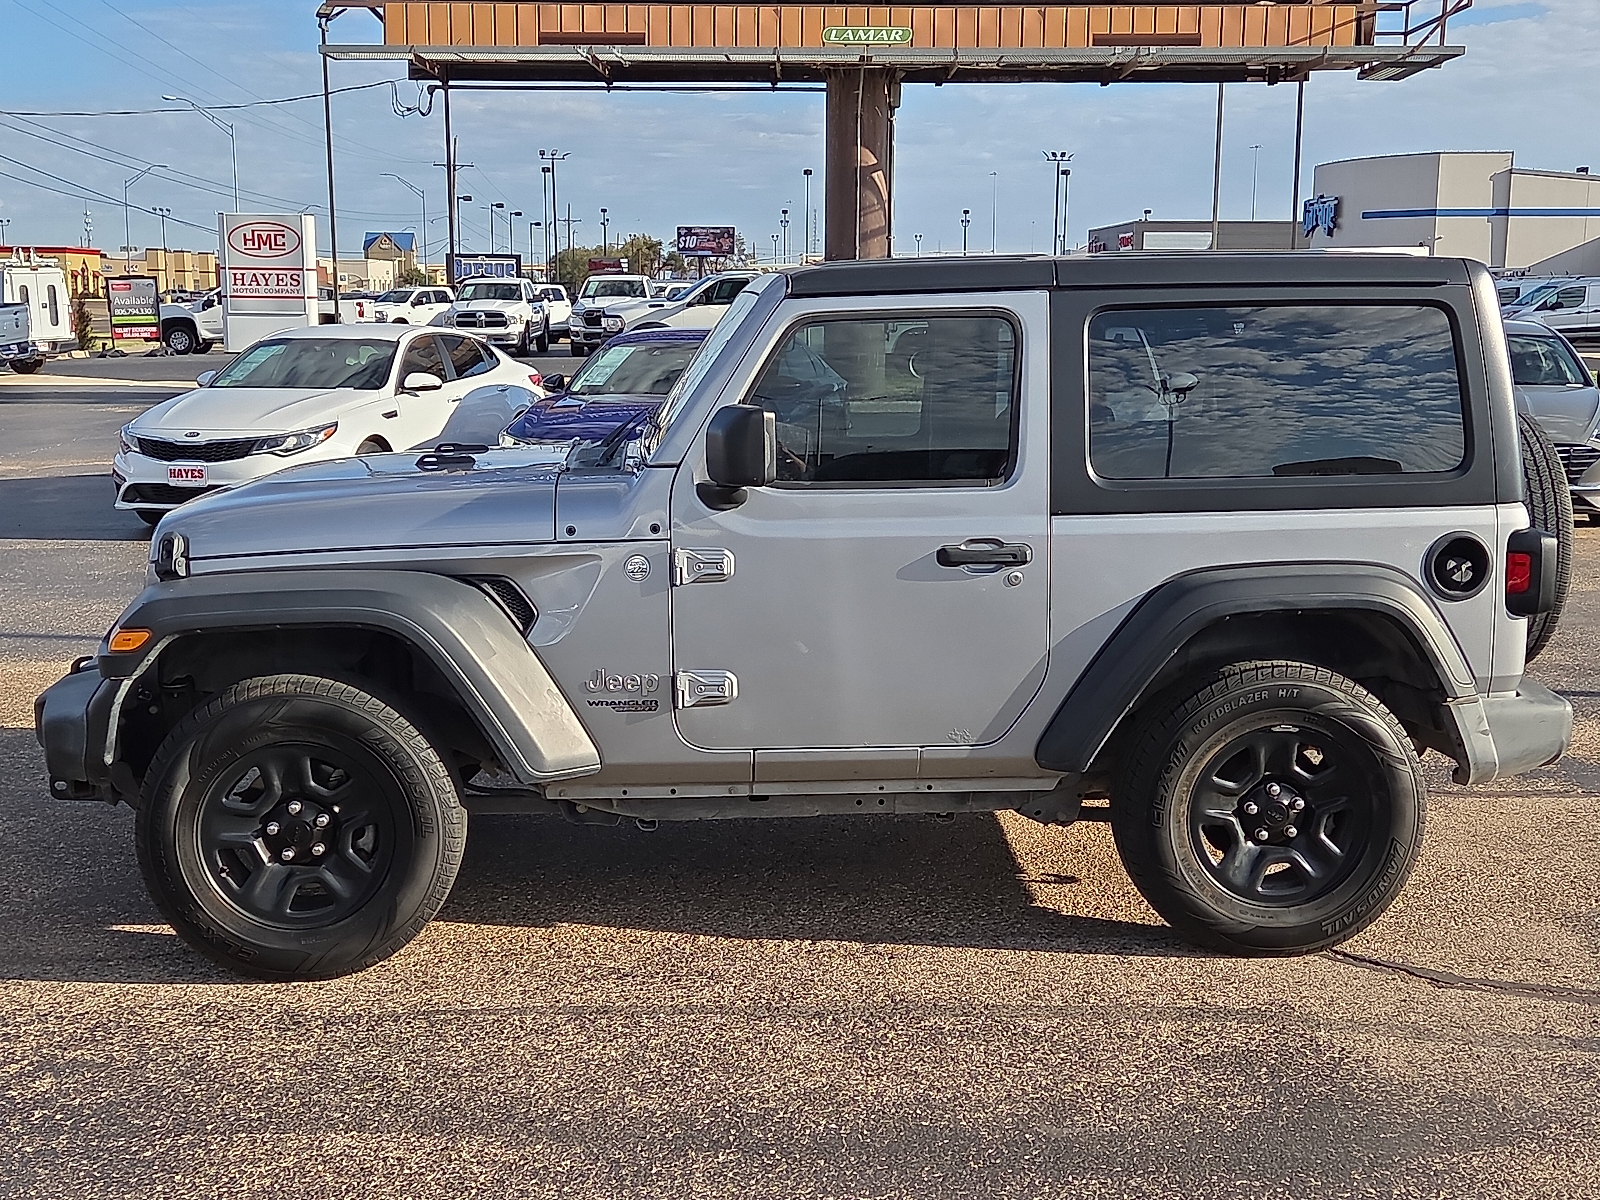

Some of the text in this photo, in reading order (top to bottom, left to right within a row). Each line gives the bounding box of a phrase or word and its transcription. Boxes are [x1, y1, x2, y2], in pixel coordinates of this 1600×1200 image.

[829, 29, 904, 41] LAMAR
[242, 229, 287, 251] HMC
[678, 235, 697, 249] $10
[231, 272, 301, 287] HAYES
[263, 287, 301, 295] COMPANY
[113, 295, 154, 305] Available
[168, 468, 205, 479] HAYES
[584, 667, 660, 697] Jeep
[586, 699, 659, 707] WRANGLER
[1192, 688, 1300, 735] ROADBLAZER H/T
[1321, 836, 1407, 936] LANDSAIL
